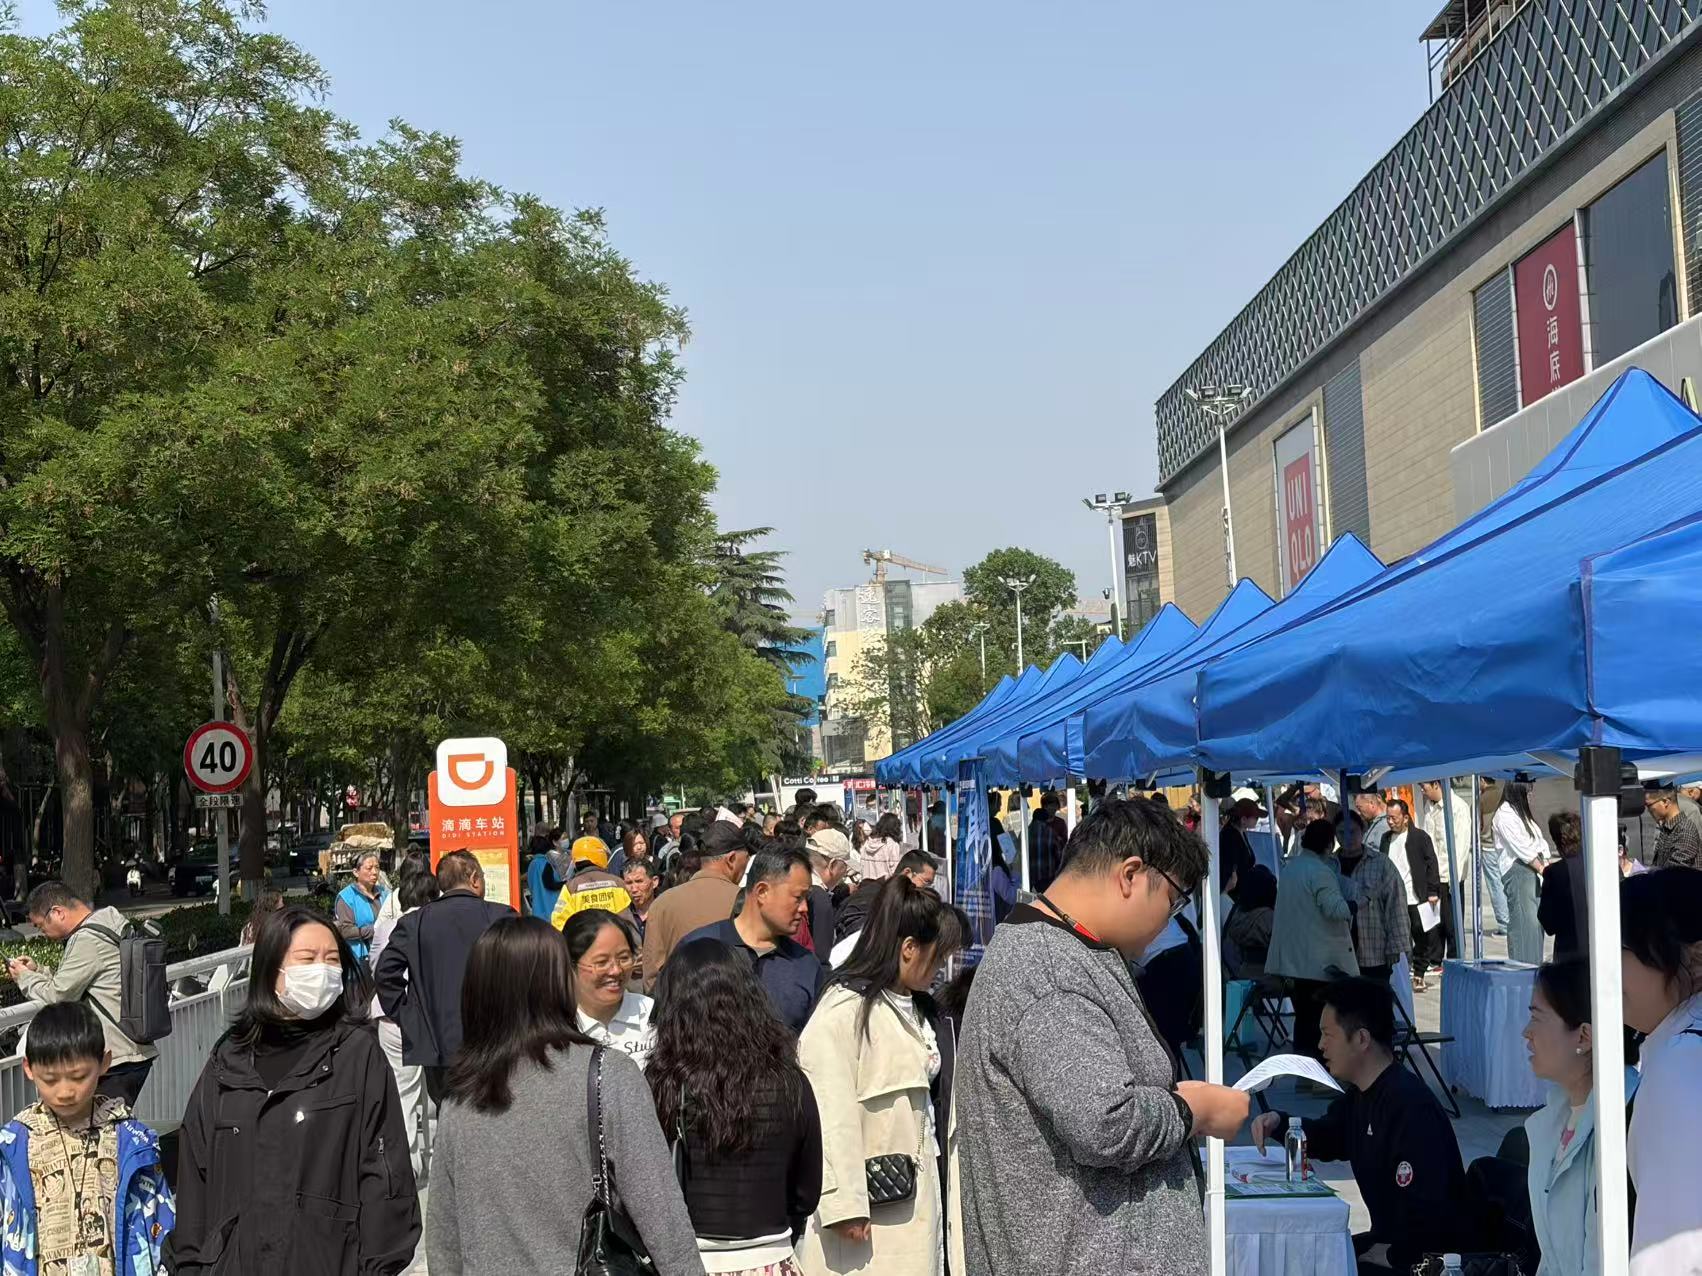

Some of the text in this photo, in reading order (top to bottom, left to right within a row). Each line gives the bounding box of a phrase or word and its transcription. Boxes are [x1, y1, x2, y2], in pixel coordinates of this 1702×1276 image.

[1546, 315, 1561, 392] 海底
[1287, 471, 1308, 521] UNI
[1291, 525, 1312, 580] QLO
[199, 741, 237, 774] 40
[783, 776, 803, 785] Cotti
[441, 816, 504, 832] 滴滴车站
[466, 830, 505, 838] STATION
